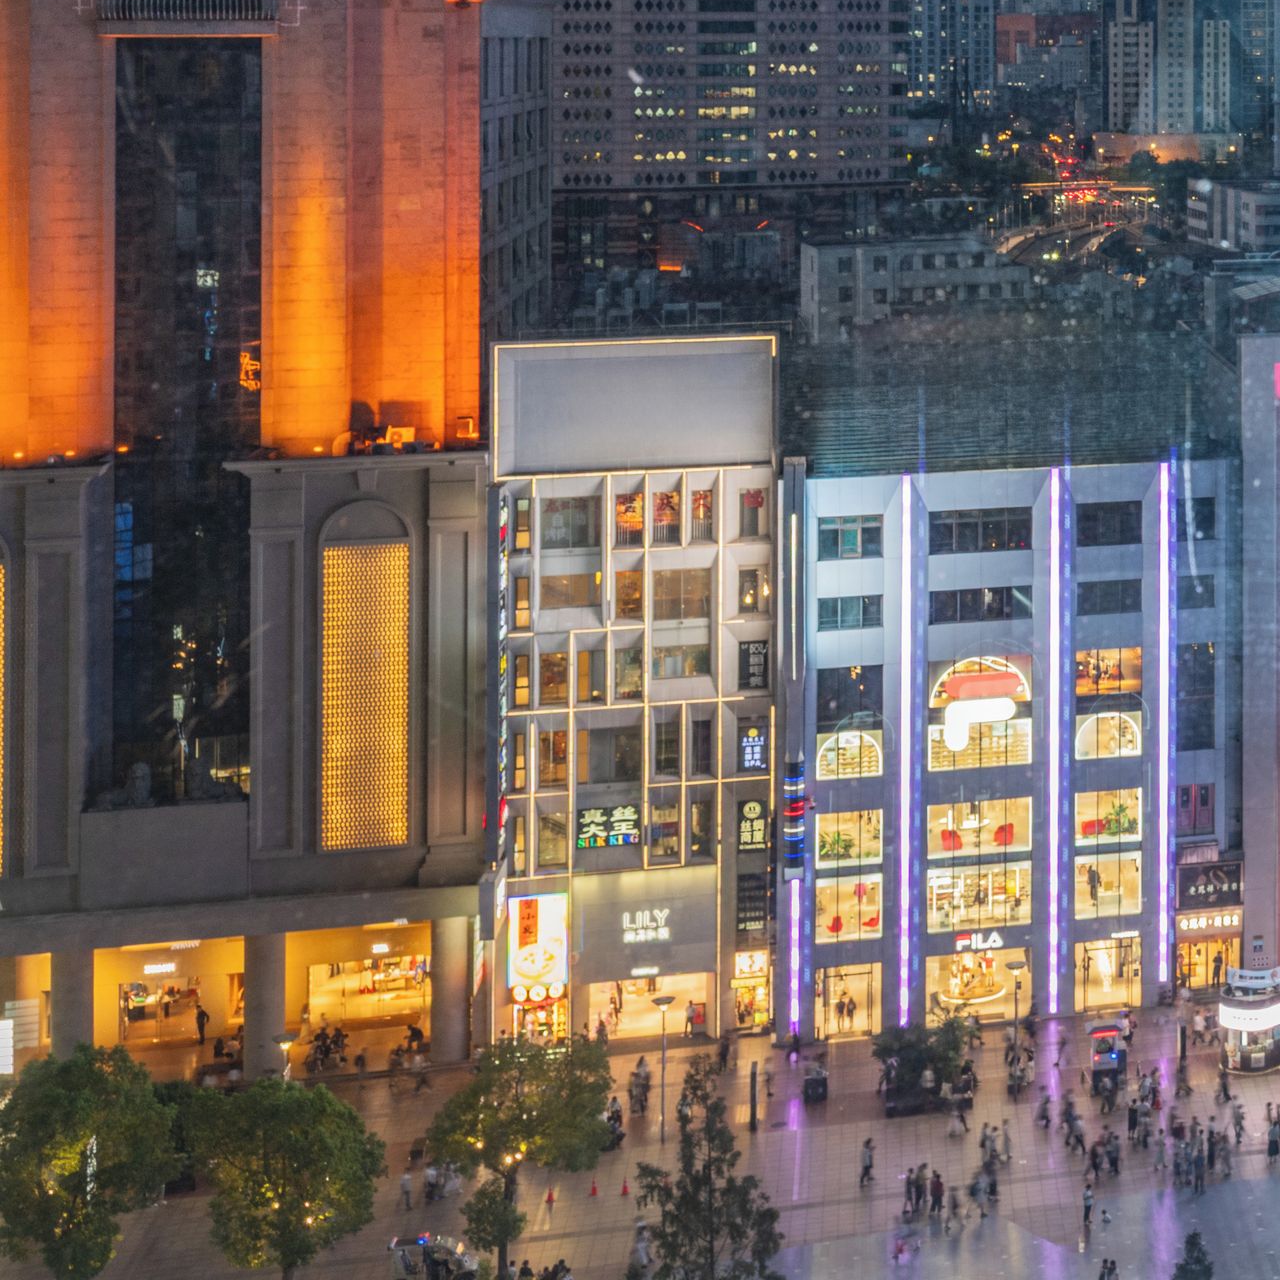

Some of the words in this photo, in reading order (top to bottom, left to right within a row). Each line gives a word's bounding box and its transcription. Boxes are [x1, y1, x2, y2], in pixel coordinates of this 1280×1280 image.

[744, 759, 761, 767] SPA
[579, 806, 638, 824] 真丝
[579, 821, 639, 838] 大王
[577, 837, 606, 849] SILK
[608, 834, 639, 845] KING
[623, 909, 670, 929] LILY
[955, 931, 1004, 951] FILA
